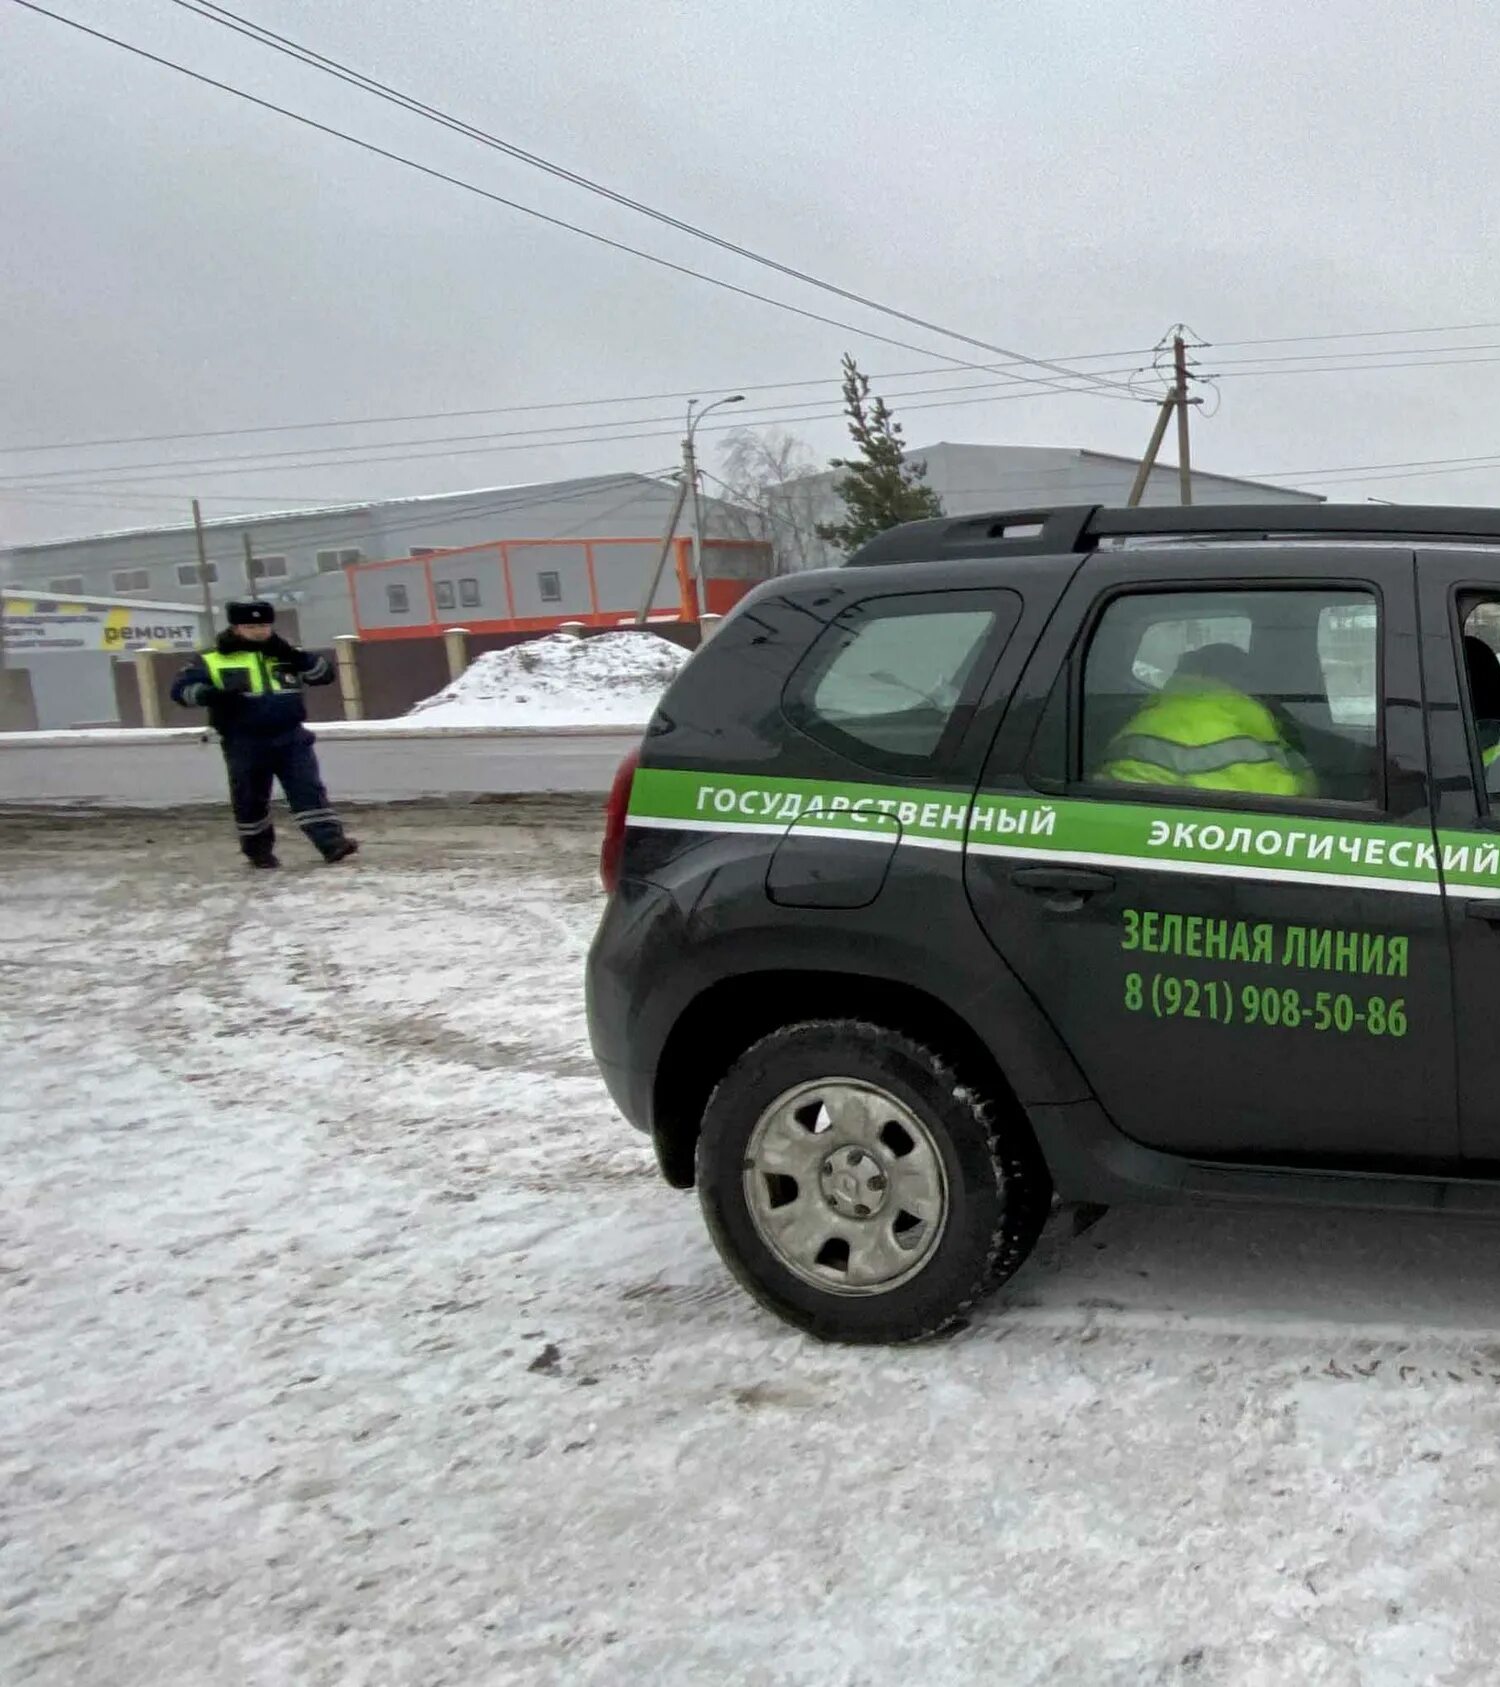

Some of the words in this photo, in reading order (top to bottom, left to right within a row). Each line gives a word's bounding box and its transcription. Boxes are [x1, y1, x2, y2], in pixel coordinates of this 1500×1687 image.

[104, 626, 194, 644] ремонт
[696, 786, 1057, 835] ГОСУДАРСТВЕННЫЙ
[1147, 820, 1500, 875] ЭКОЛОГИЧЕСКИЙ
[1121, 909, 1273, 964] ЗЕЛЕНАЯ
[1281, 926, 1409, 977] ЛИНИЯ
[1124, 972, 1143, 1011] 8
[1152, 974, 1233, 1024] (921)
[1242, 985, 1408, 1037] 908-50-86
